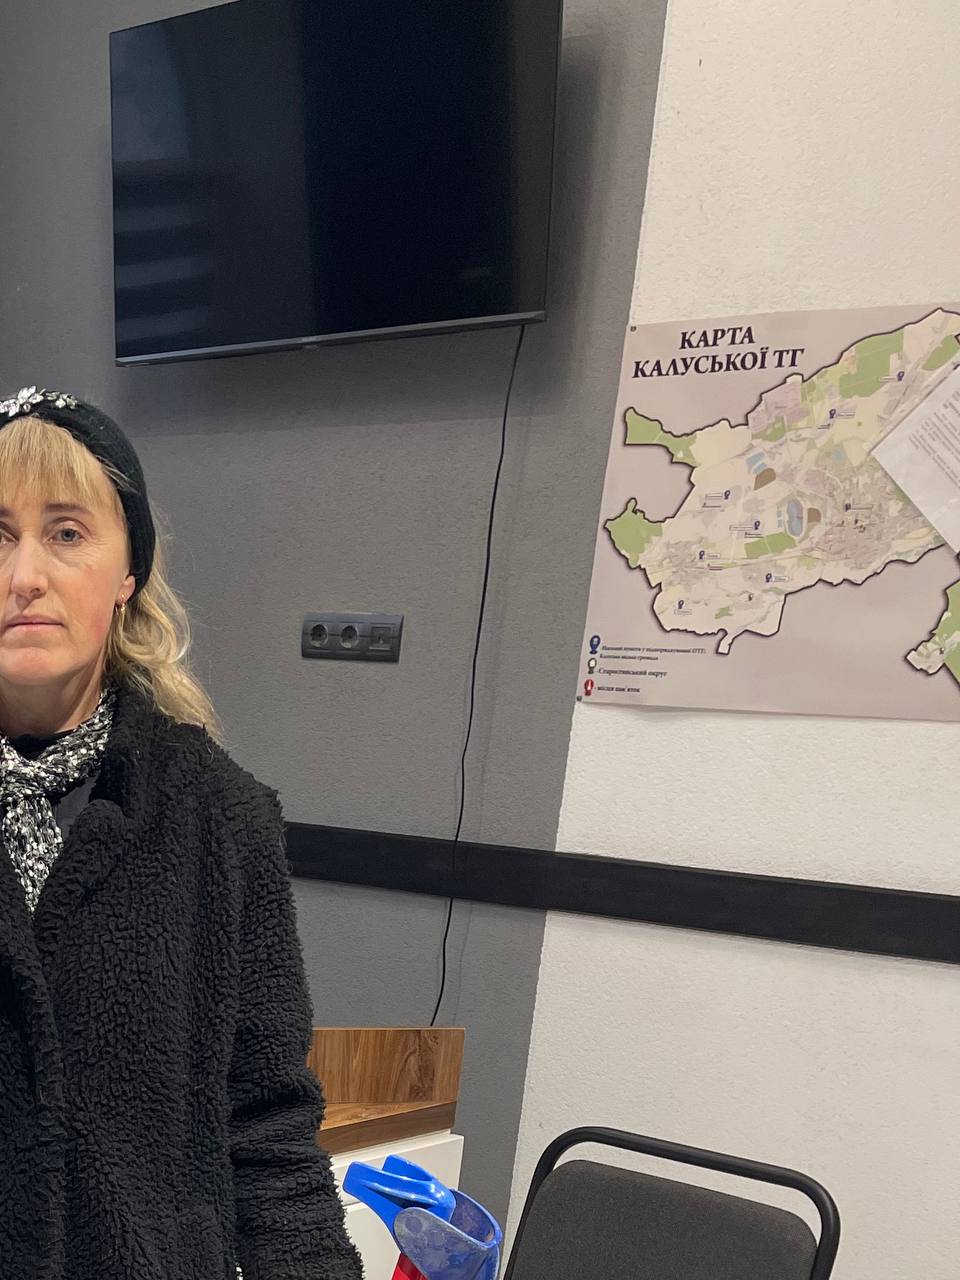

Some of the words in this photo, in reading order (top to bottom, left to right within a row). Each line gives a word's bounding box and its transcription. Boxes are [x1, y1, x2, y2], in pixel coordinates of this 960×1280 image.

[679, 326, 755, 350] КАРТА
[632, 347, 769, 378] КАЛУСЬКОЇ
[773, 348, 805, 368] ТГ
